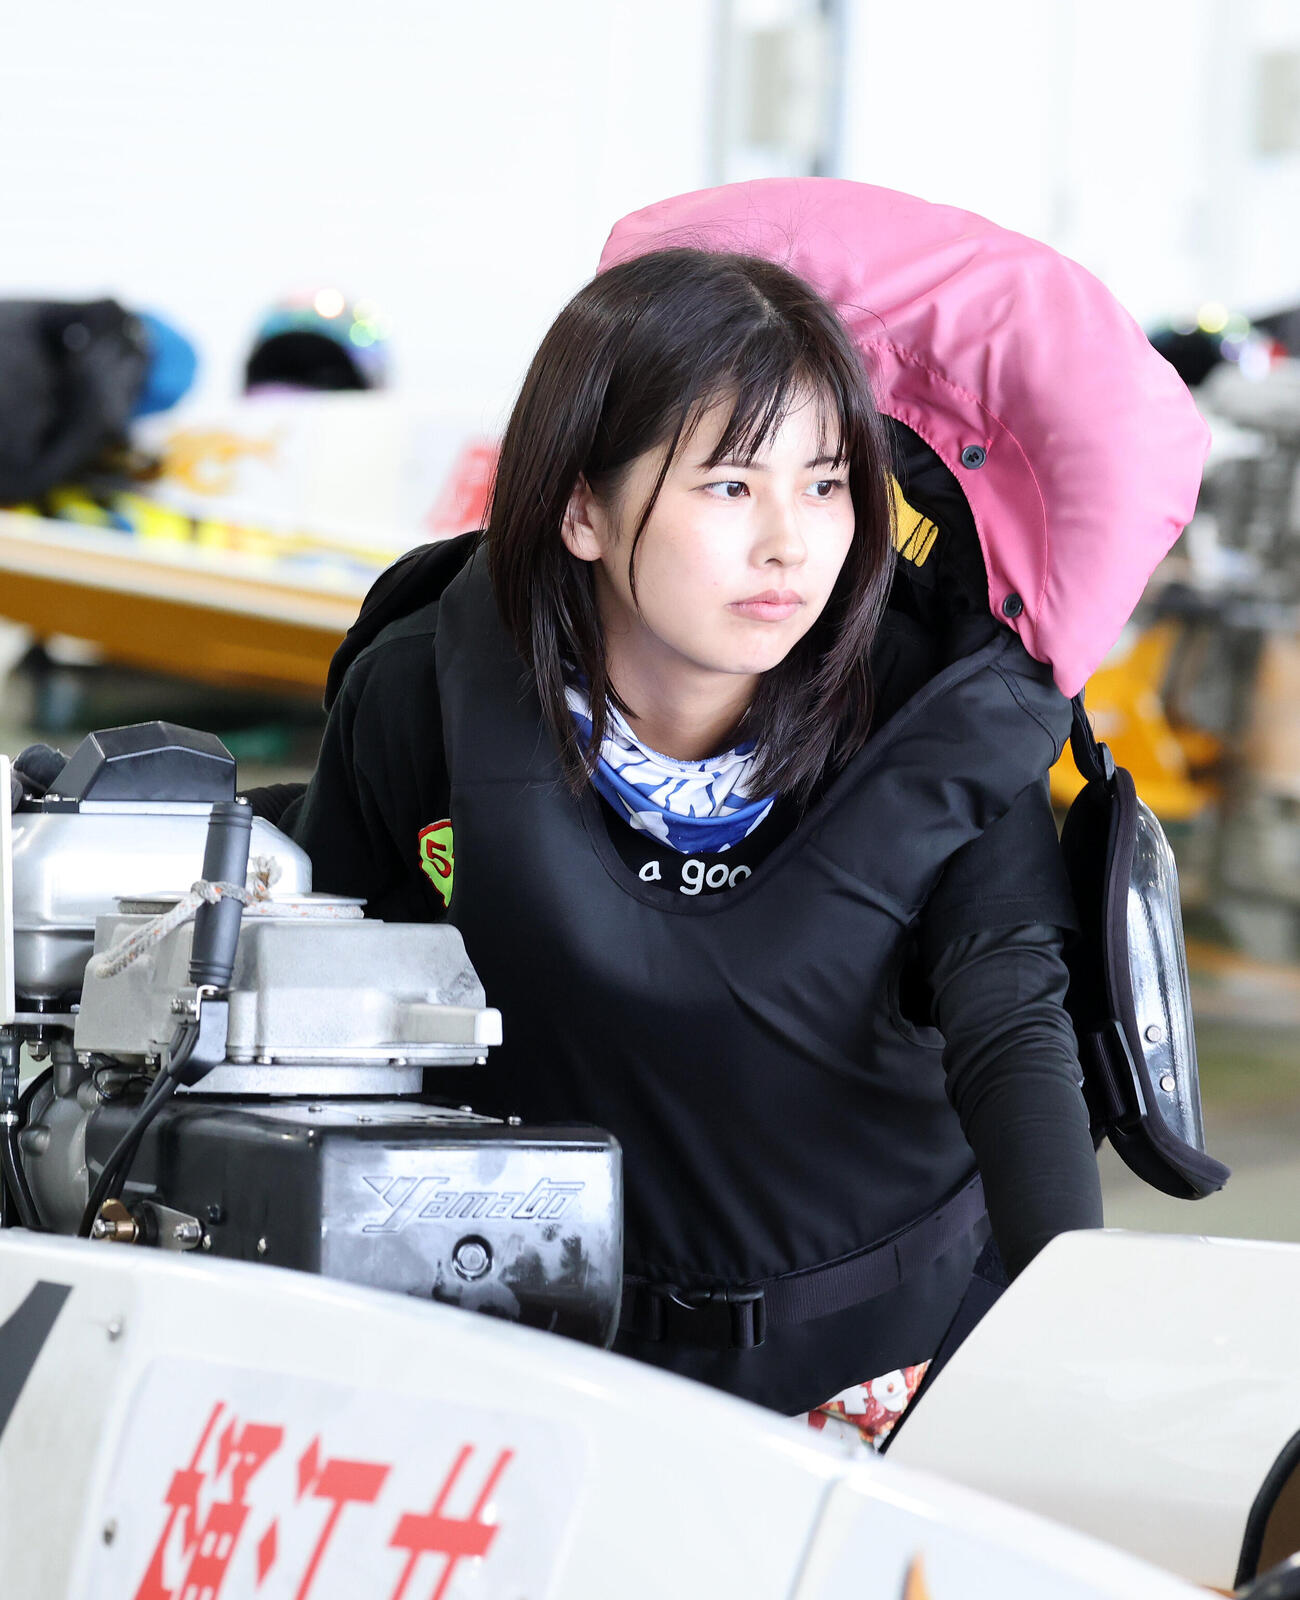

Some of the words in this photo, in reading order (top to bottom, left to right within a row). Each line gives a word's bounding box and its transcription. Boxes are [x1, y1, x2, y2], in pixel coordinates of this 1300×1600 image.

[426, 838, 452, 879] 5
[638, 859, 662, 882] a
[362, 1176, 586, 1233] Yamato
